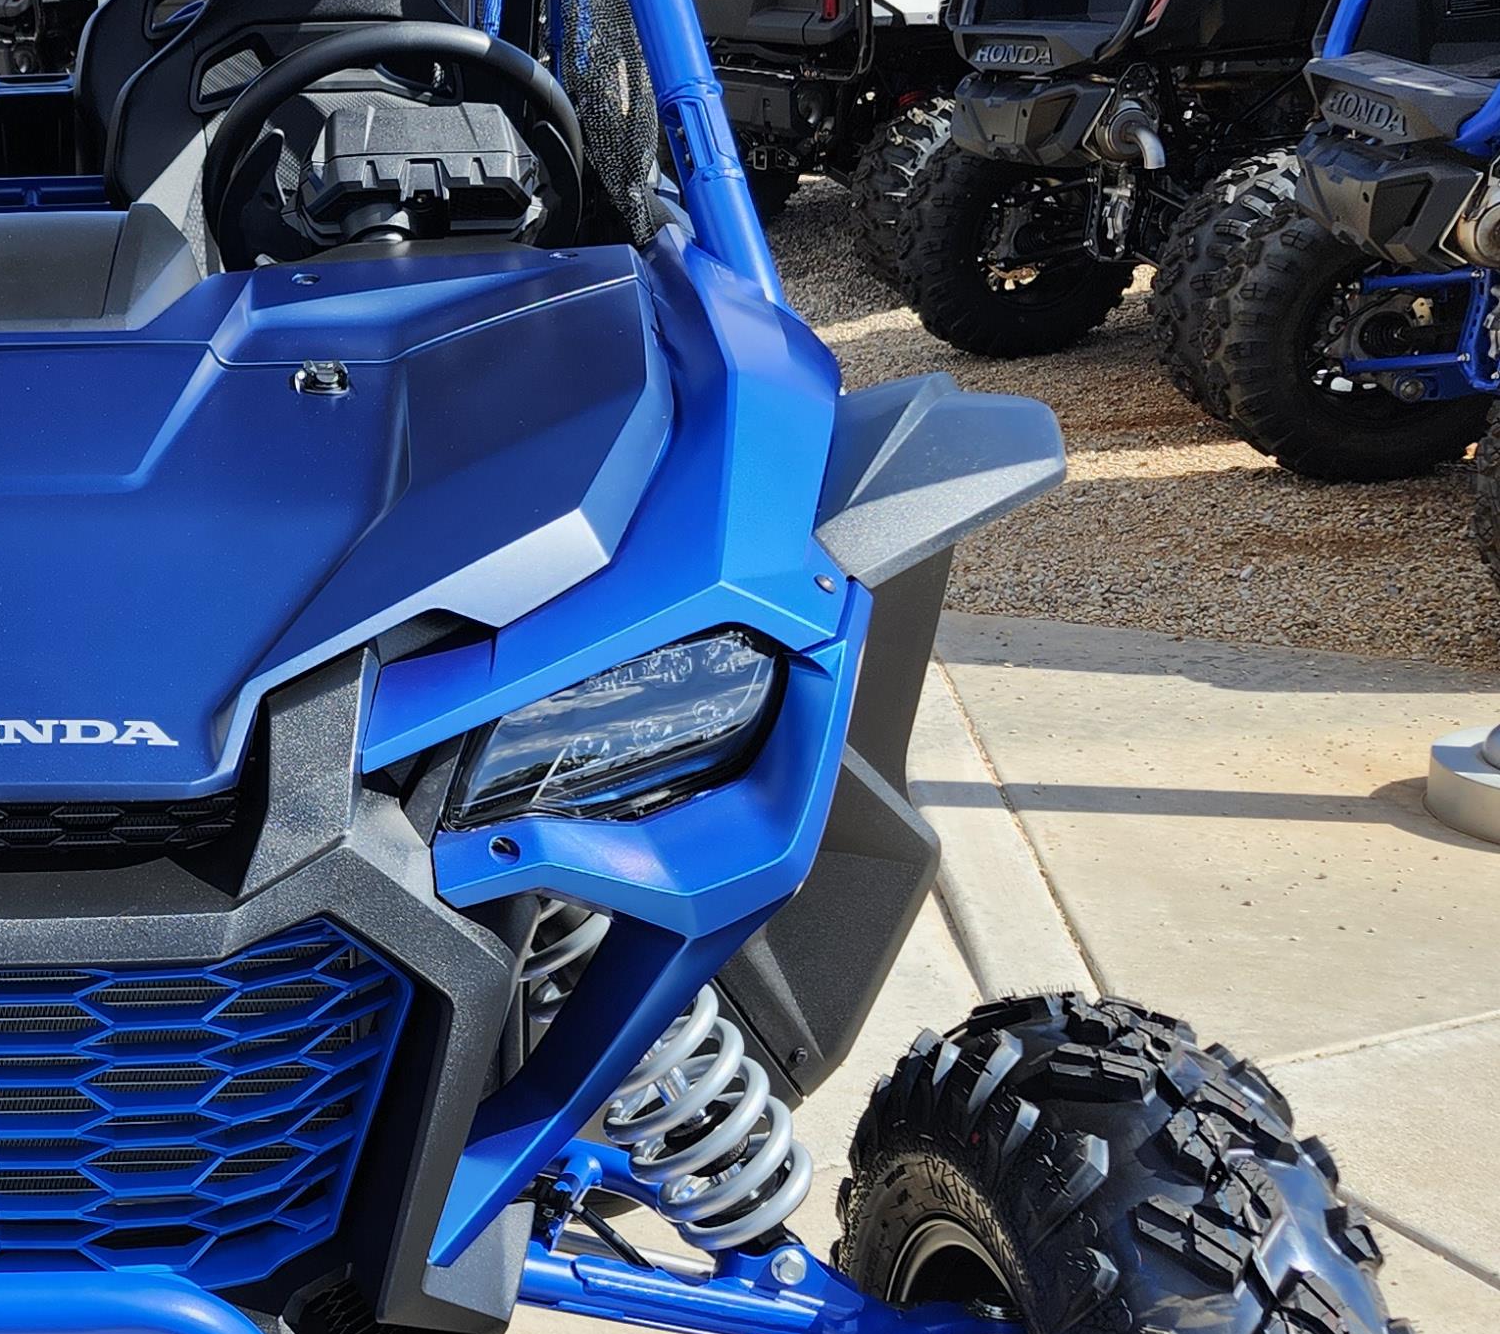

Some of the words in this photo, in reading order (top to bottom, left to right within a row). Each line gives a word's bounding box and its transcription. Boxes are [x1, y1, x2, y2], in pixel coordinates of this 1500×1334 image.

[974, 43, 1054, 66] HONDA
[1326, 89, 1408, 137] HONDA
[924, 1154, 1028, 1286] KEND
